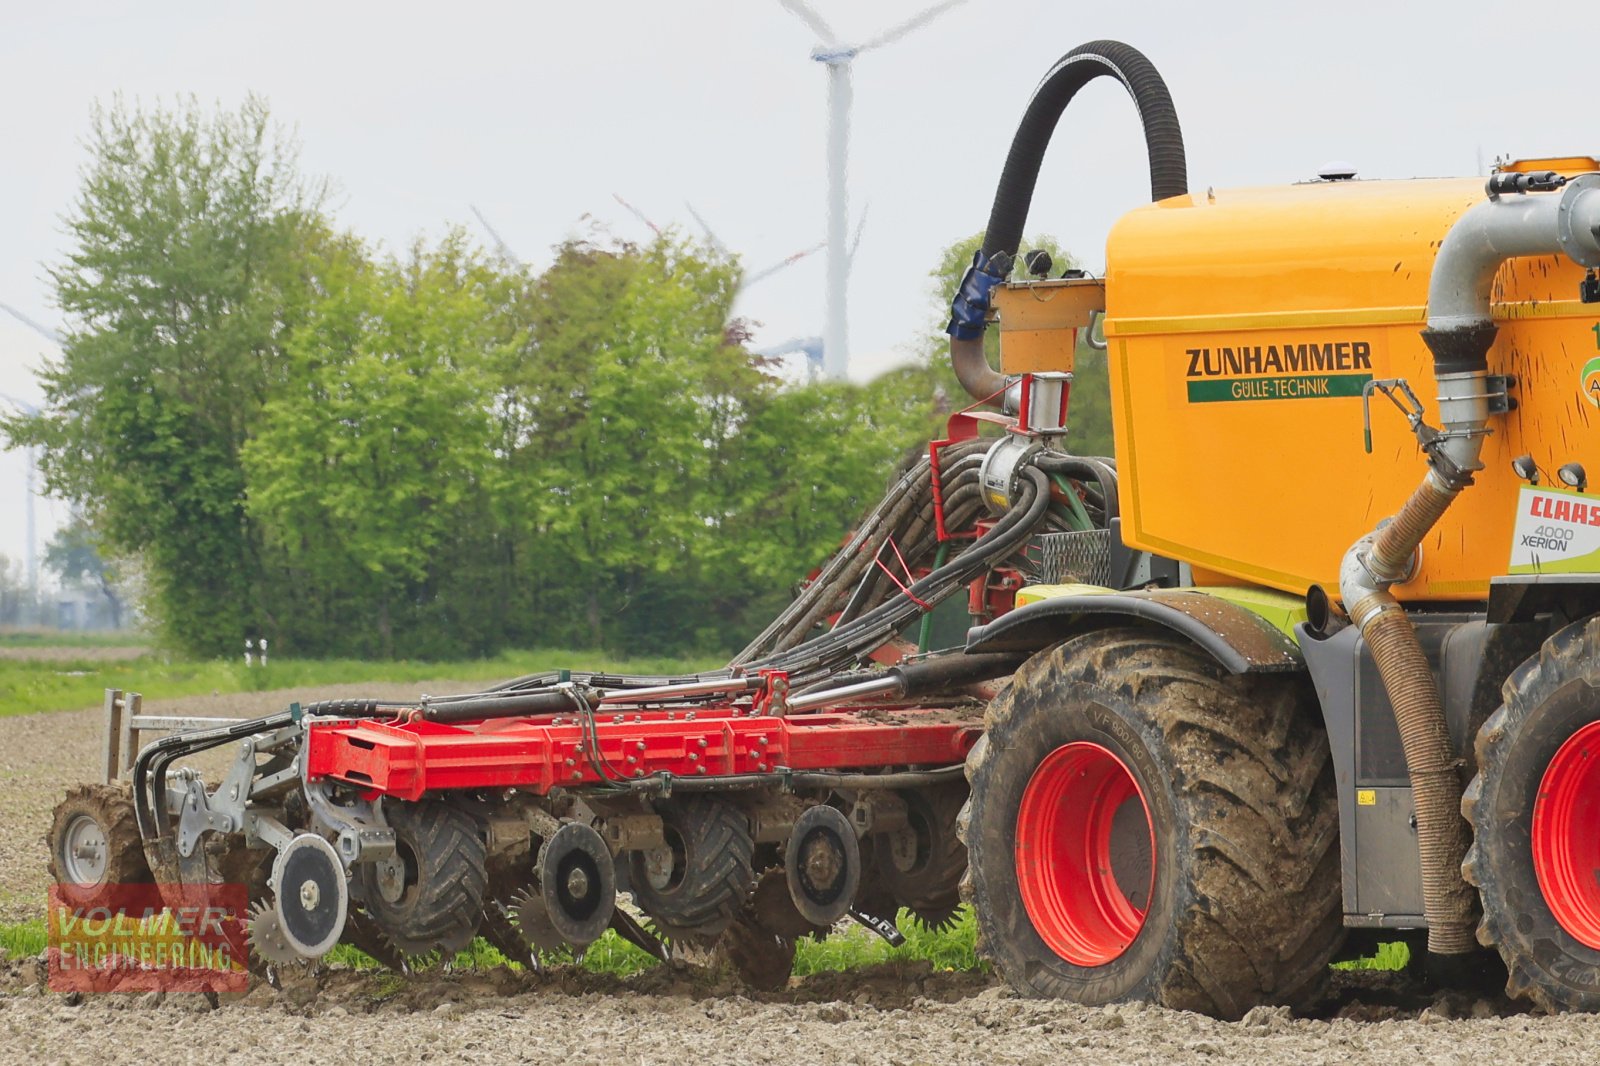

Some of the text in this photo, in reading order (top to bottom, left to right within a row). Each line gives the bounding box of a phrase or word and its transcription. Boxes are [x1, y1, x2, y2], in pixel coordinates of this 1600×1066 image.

[1186, 342, 1372, 376] ZUNHAMMER
[1231, 378, 1330, 398] GÜLLE-TECHNIK
[1530, 496, 1600, 527] CLAAS
[1521, 534, 1568, 552] XERION
[1535, 525, 1574, 541] 4000
